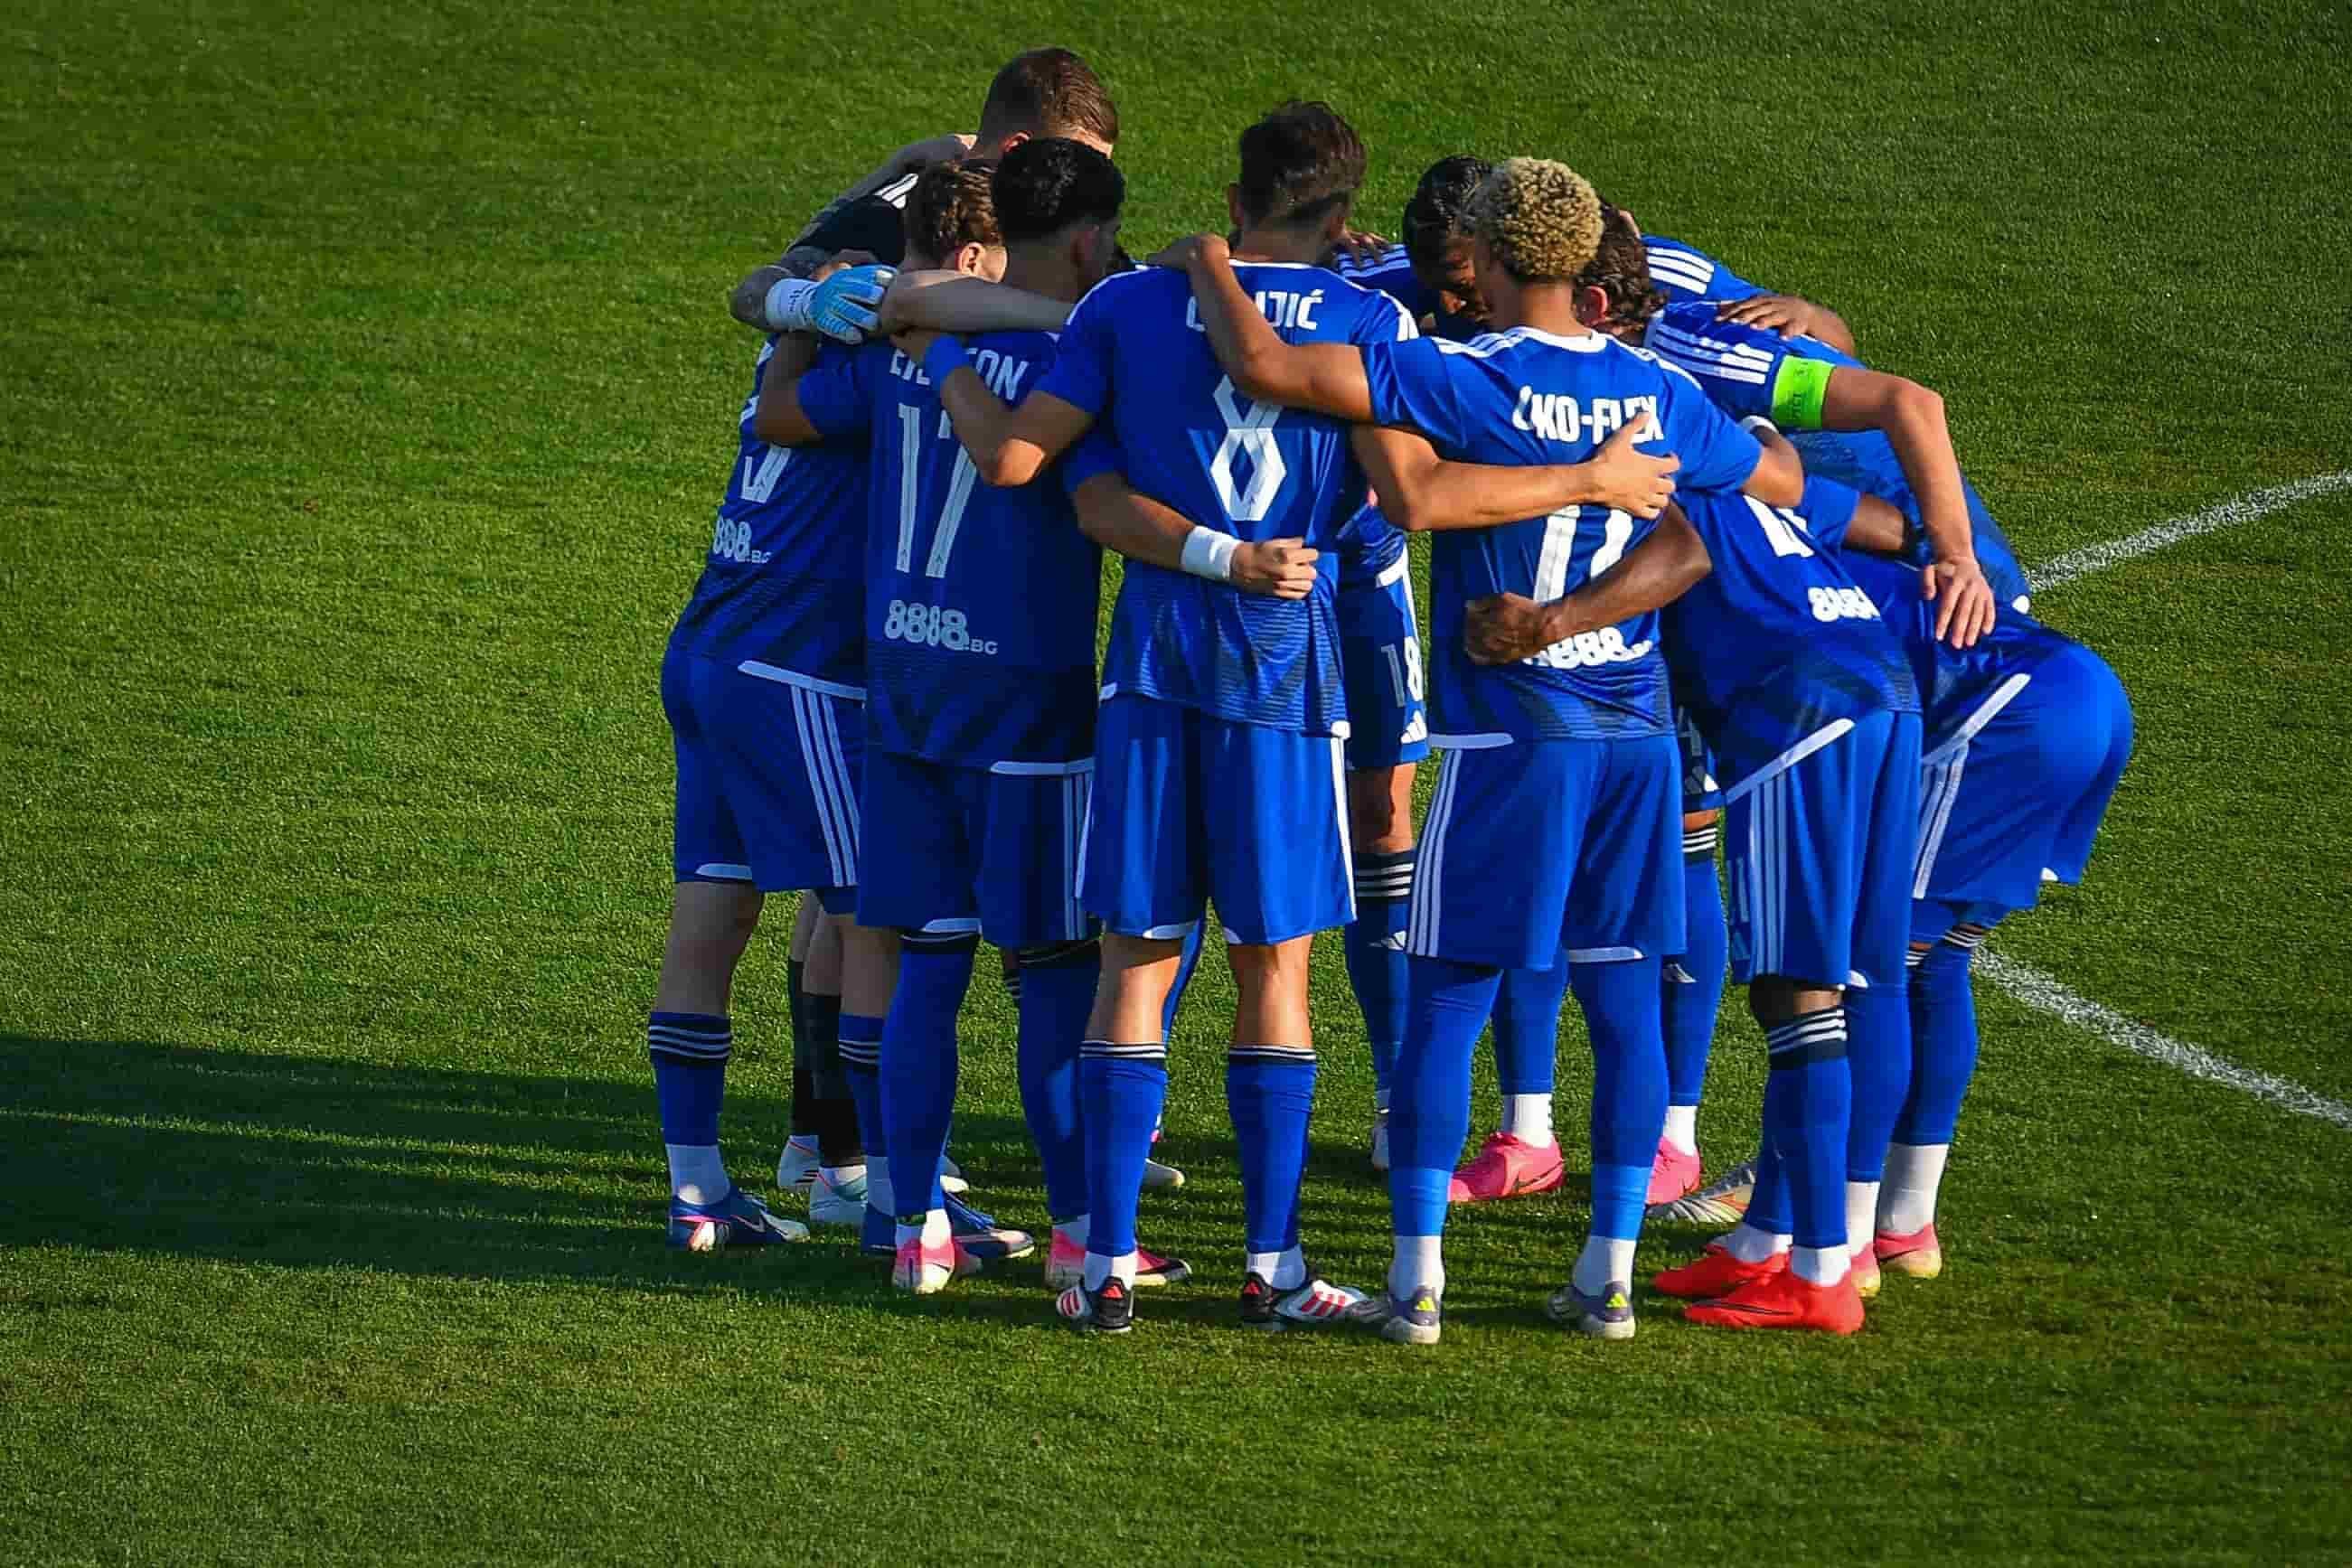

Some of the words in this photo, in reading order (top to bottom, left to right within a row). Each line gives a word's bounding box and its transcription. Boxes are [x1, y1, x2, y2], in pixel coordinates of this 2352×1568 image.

[896, 402, 978, 578] 17
[1210, 373, 1287, 521] 8
[1380, 635, 1424, 708] 18
